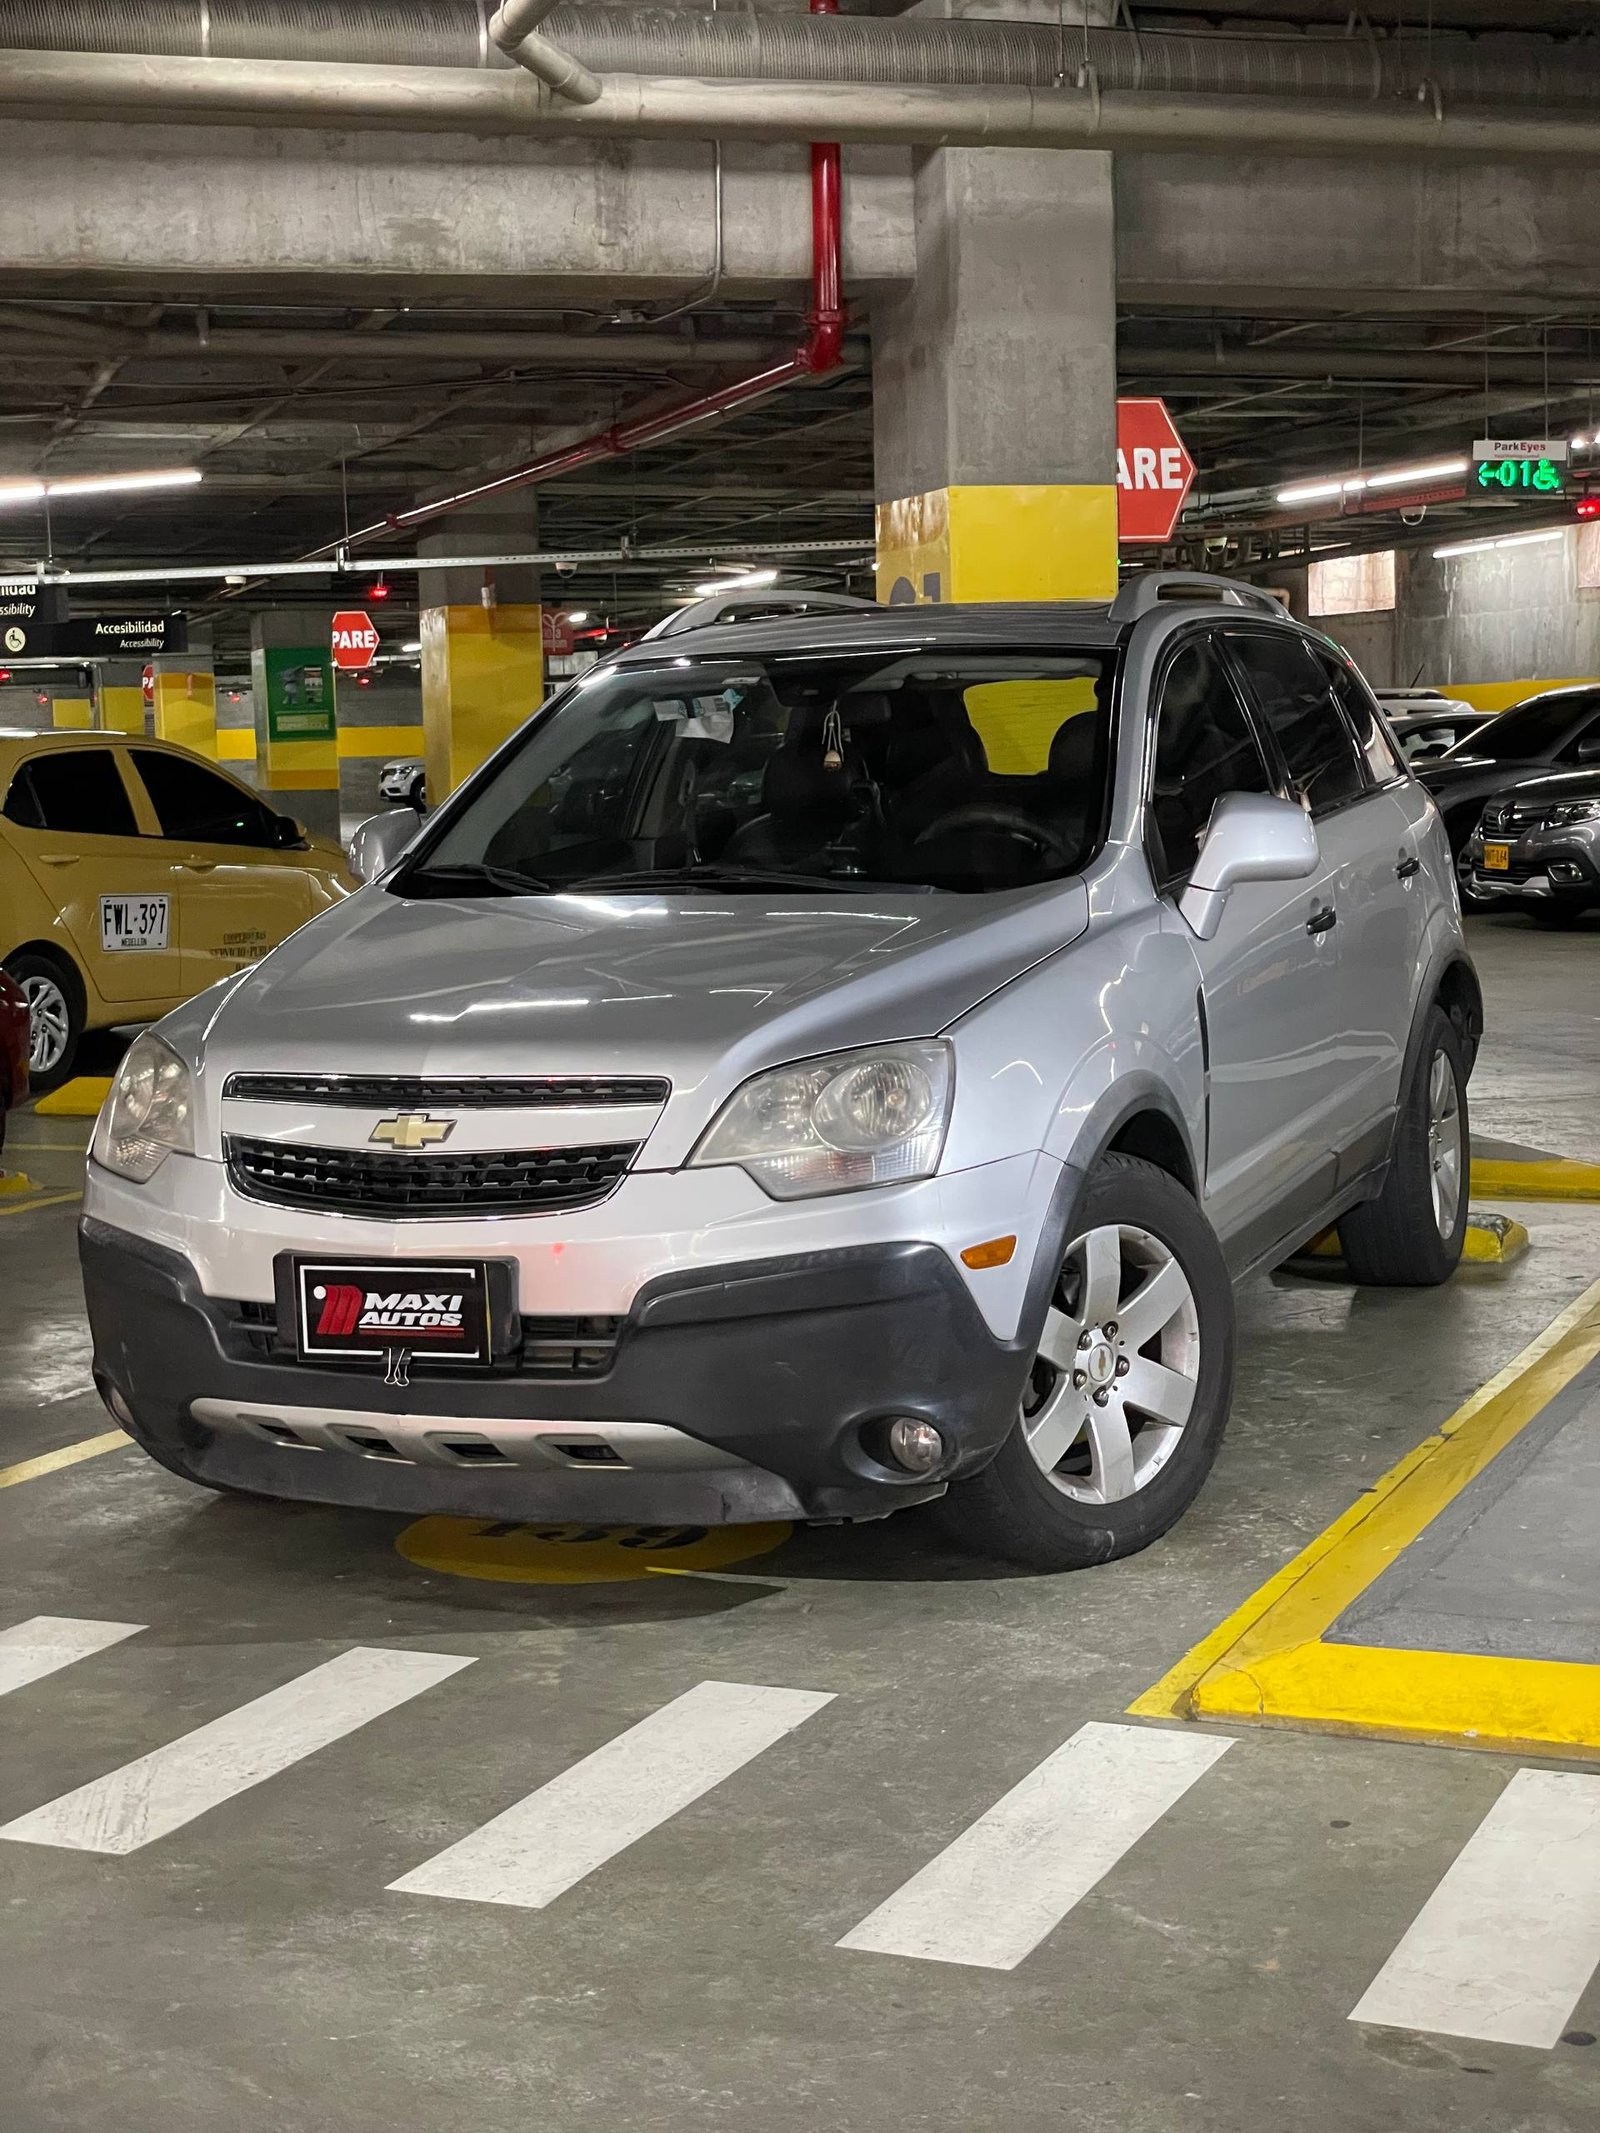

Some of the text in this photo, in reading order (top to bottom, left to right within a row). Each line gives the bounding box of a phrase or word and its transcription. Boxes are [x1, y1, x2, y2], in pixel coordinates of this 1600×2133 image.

[1494, 442, 1546, 453] ParkEyes
[95, 620, 165, 634] Accesibilidad
[120, 638, 164, 649] Accessibility
[332, 630, 376, 649] PARE
[364, 1292, 464, 1312] MAXI
[359, 1311, 463, 1327] AUTOS
